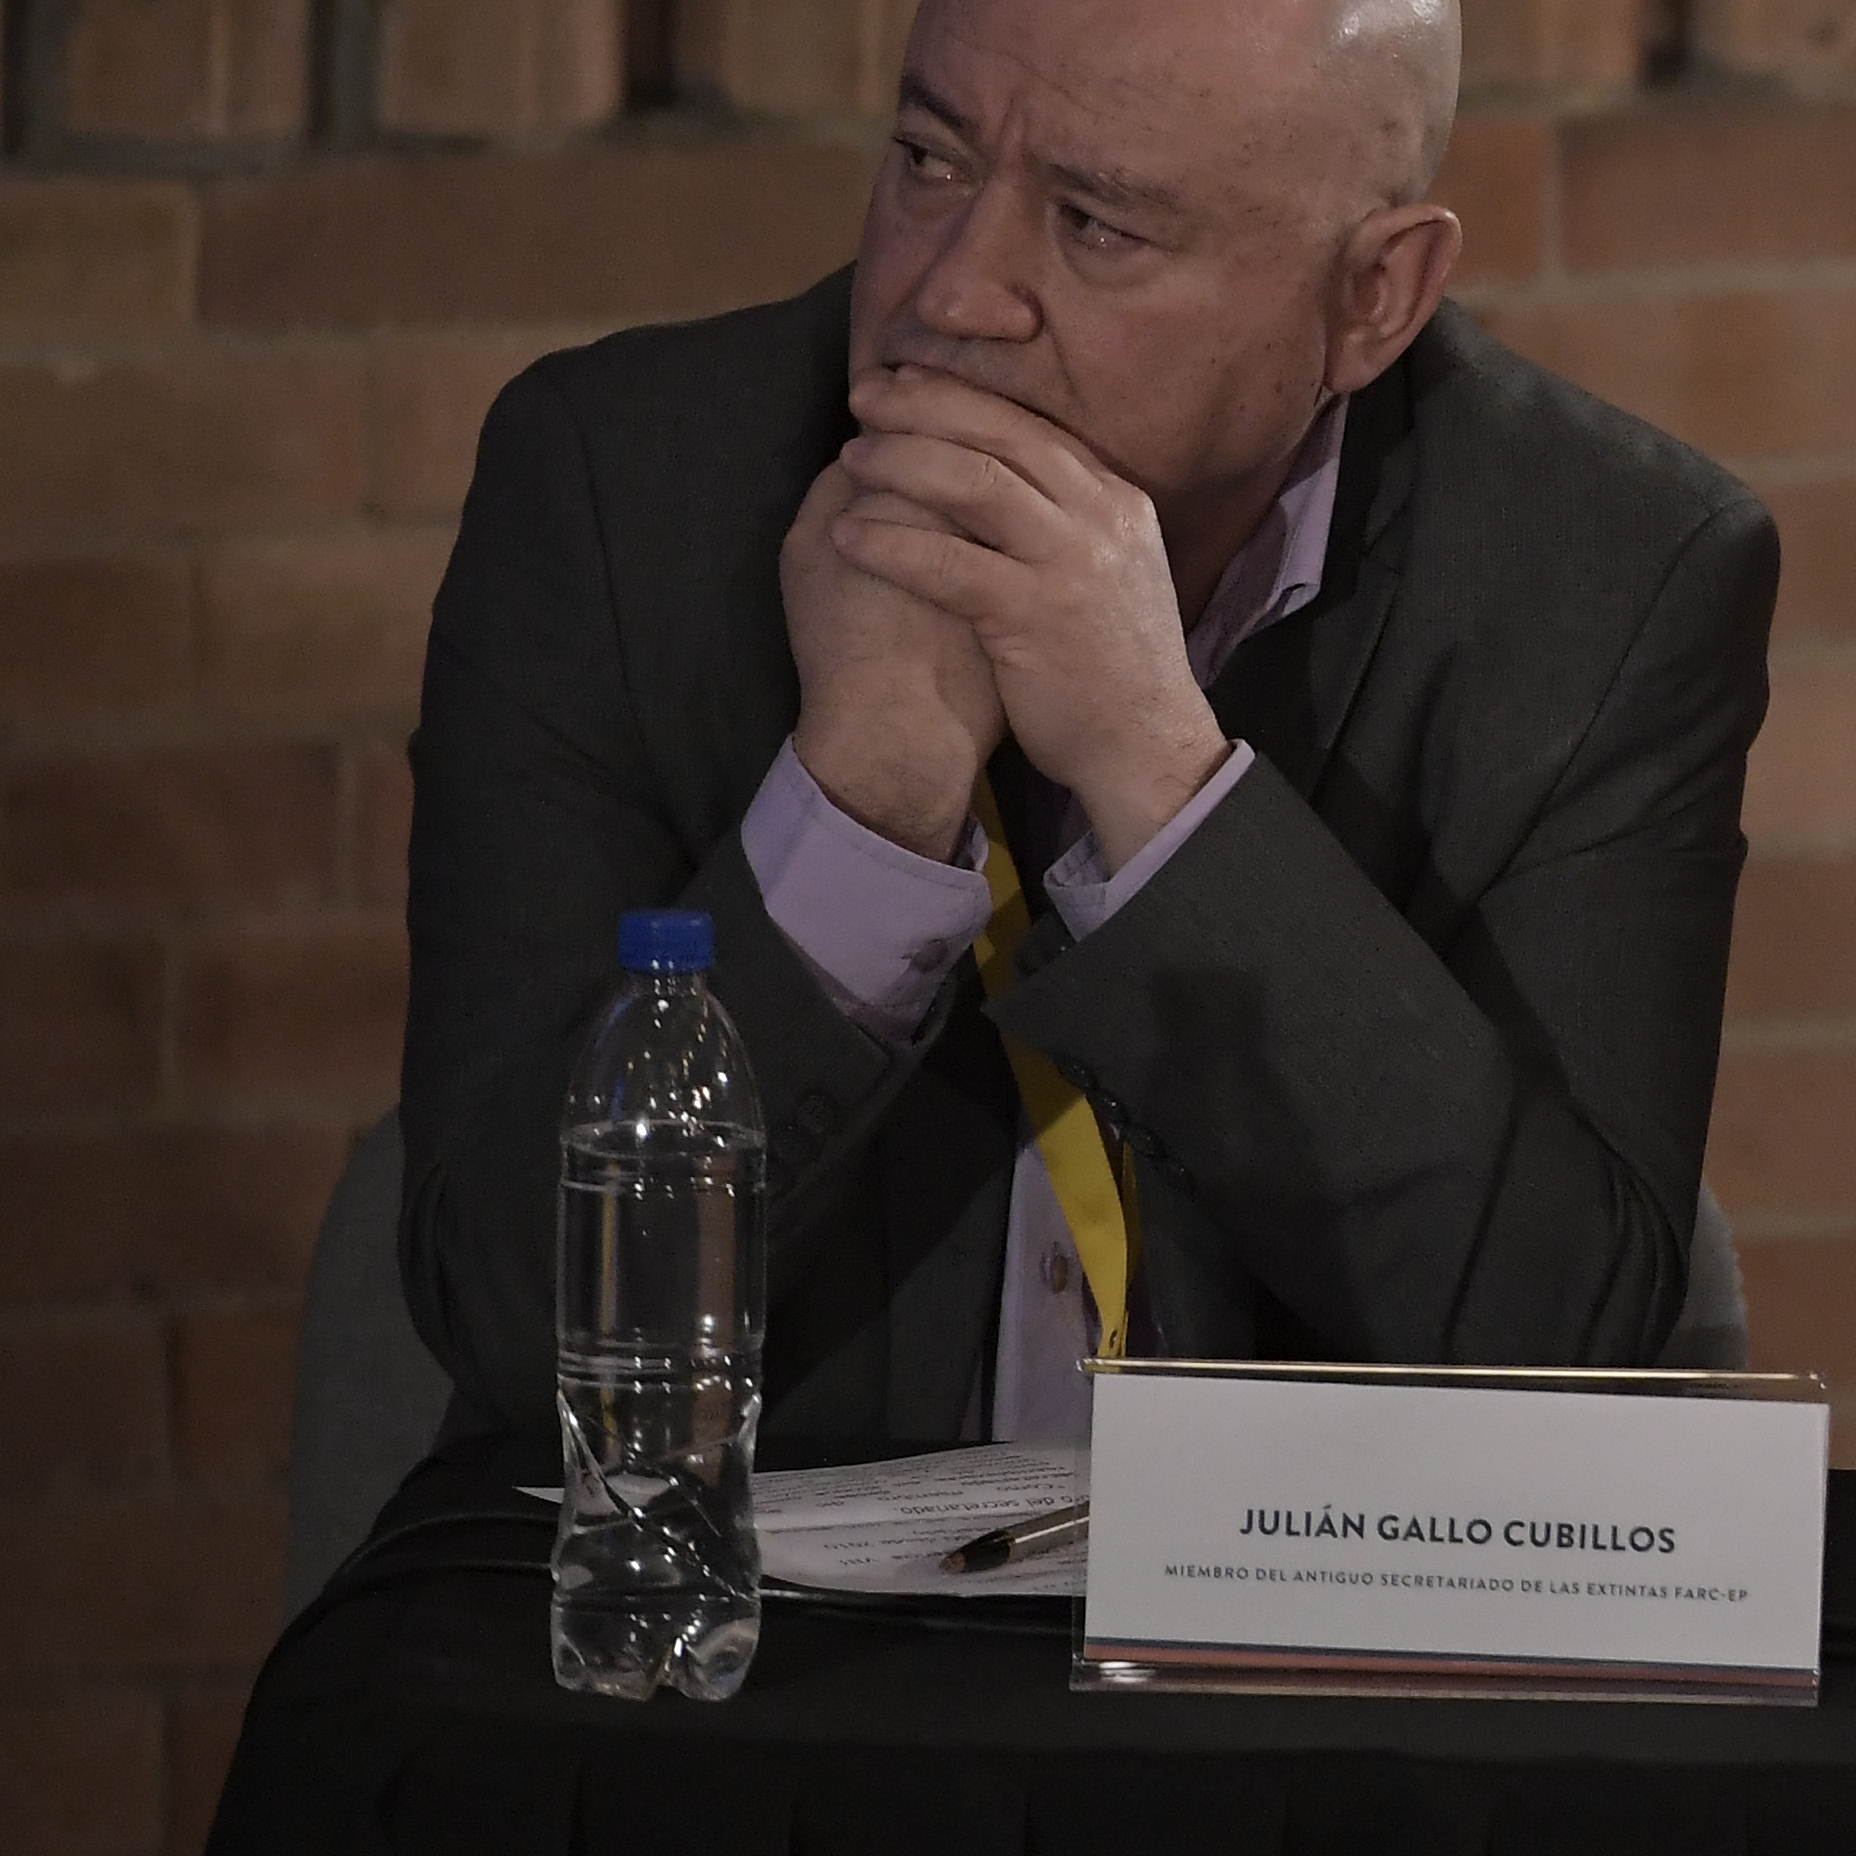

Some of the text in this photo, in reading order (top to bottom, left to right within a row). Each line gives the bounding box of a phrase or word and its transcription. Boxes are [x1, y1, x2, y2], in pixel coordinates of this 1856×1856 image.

[1239, 1503, 1676, 1554] JULIÁN GALLO CUBILLOS
[1164, 1563, 1748, 1603] MIEMBRO DEL ANTIGUO SECRETARIADO DE LAS EXTINTAS FARC-EP
